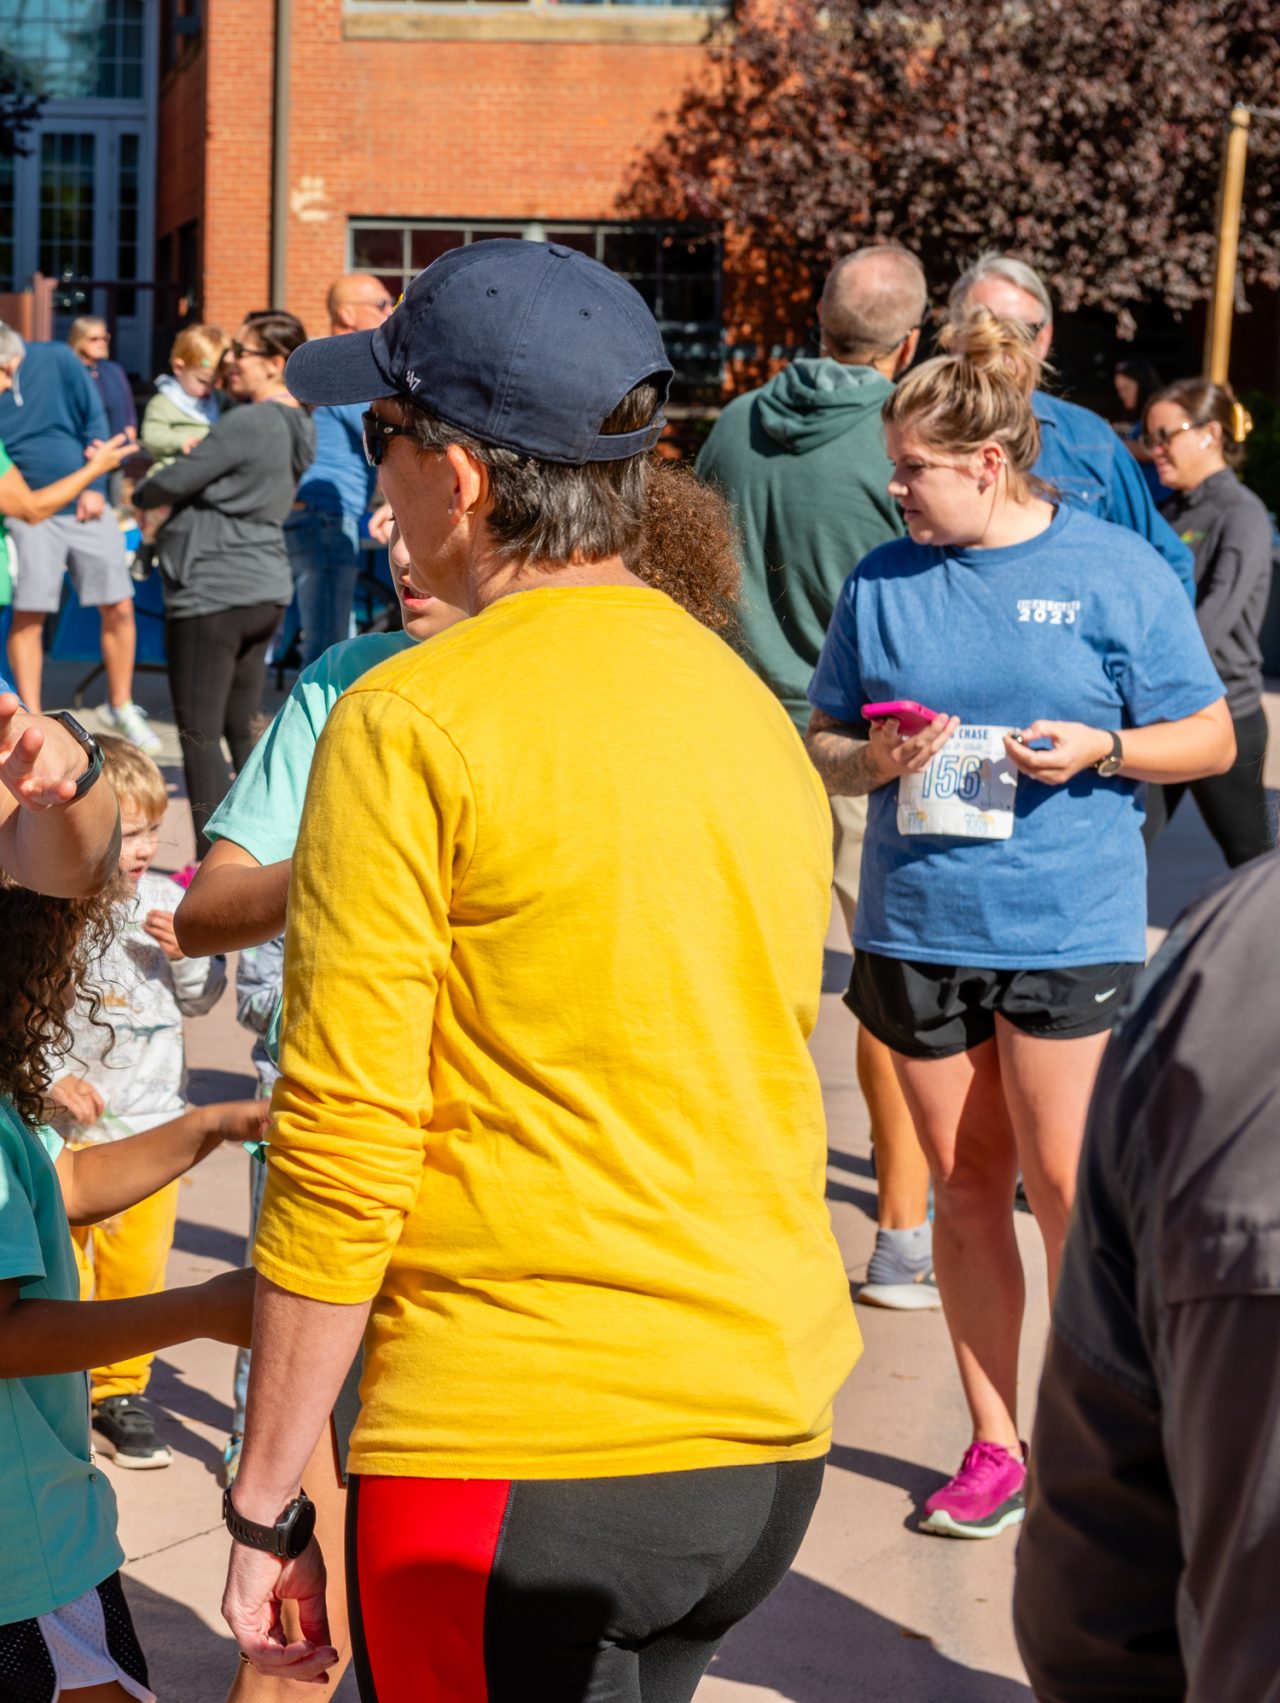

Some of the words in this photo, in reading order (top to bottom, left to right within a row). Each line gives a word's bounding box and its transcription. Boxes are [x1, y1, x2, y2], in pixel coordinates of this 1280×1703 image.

[1017, 607, 1077, 625] 2023
[958, 728, 989, 741] CHASE
[921, 753, 983, 801] 156
